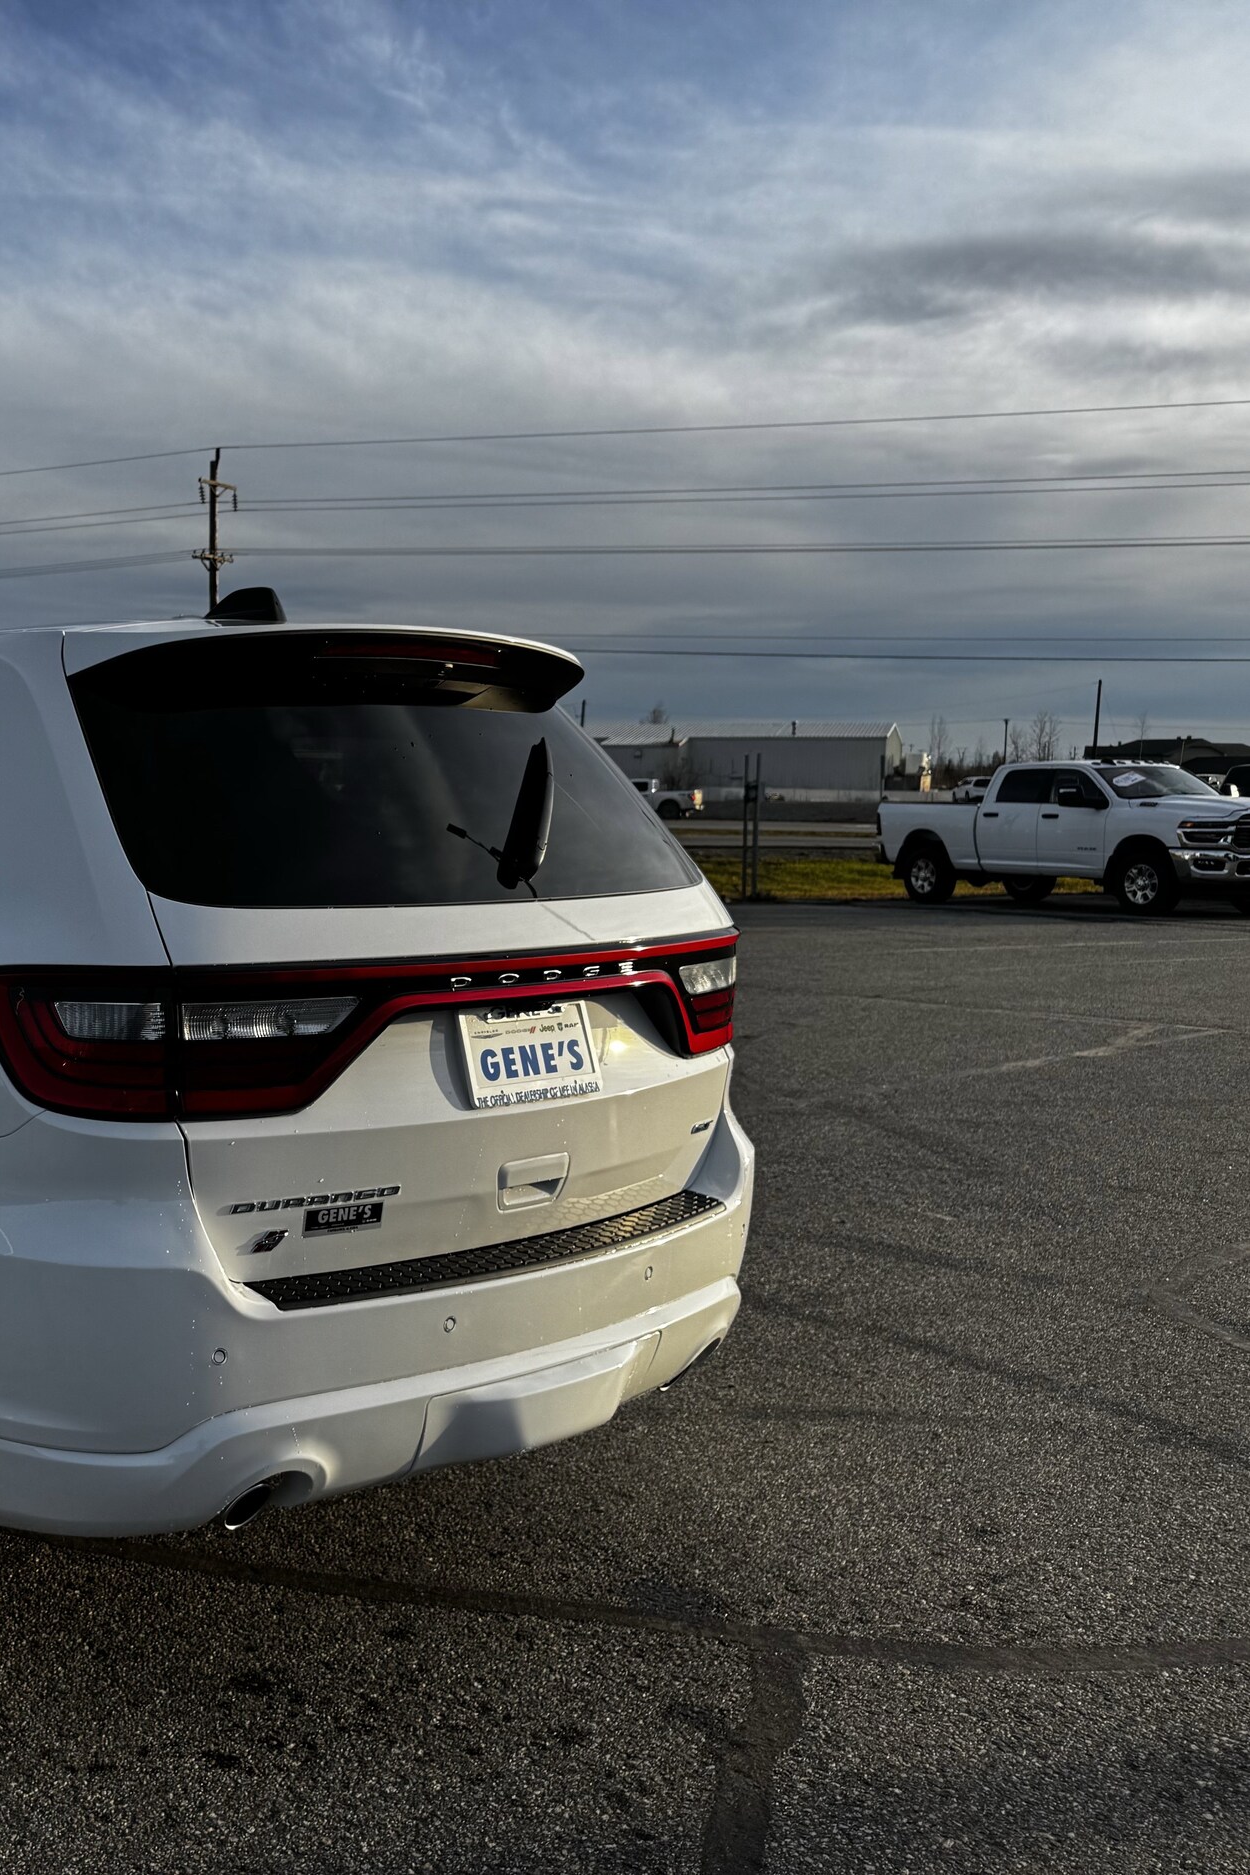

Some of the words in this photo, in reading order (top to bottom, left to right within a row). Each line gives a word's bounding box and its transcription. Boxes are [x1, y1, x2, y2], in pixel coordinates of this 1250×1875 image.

[451, 961, 634, 992] DODGE
[539, 1023, 555, 1033] Jeep
[480, 1039, 584, 1082] GENE'S
[477, 1095, 490, 1109] THE
[515, 1088, 549, 1104] DEALERSHIP
[550, 1086, 559, 1099] OF
[578, 1081, 601, 1095] ALASKA
[229, 1185, 401, 1215] DURANGO
[318, 1204, 372, 1224] GENE'S
